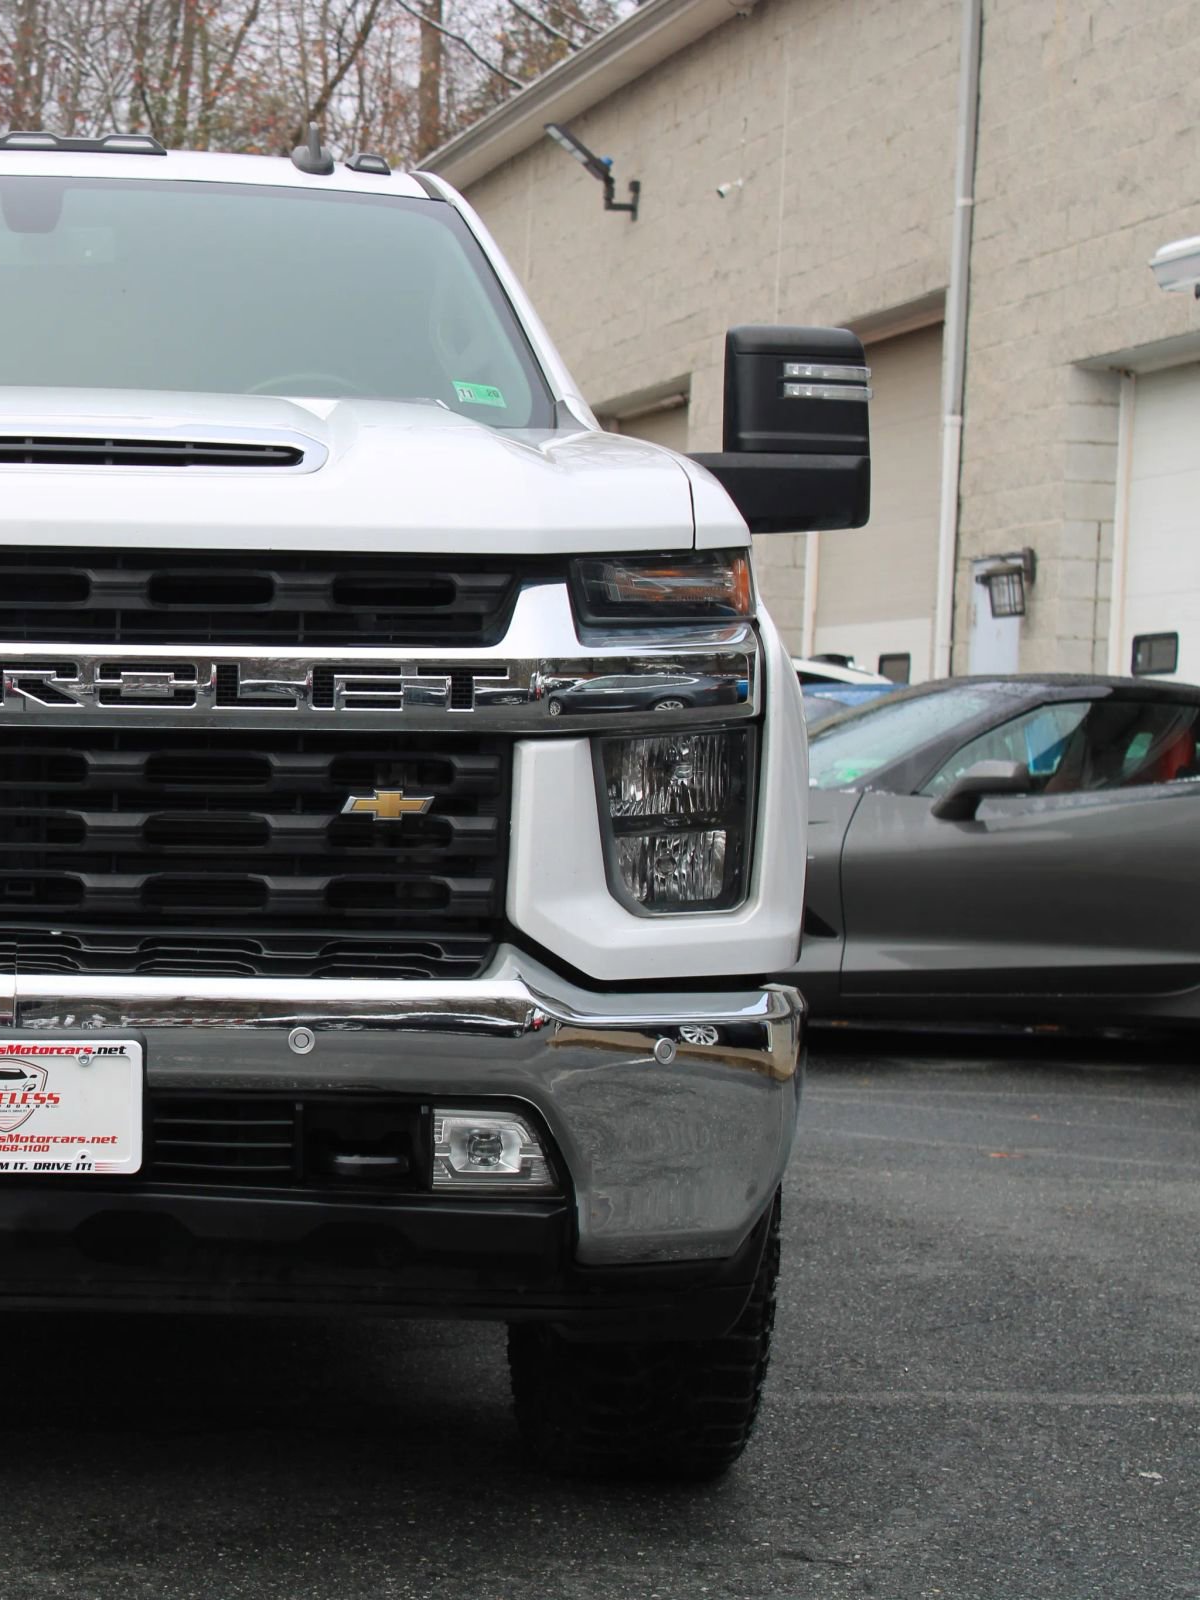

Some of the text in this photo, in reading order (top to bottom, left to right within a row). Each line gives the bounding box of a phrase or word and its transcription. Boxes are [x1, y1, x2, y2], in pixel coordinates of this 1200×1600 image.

[12, 1162, 29, 1171] IT.
[33, 1162, 71, 1171] DRIVE
[75, 1162, 92, 1171] IT!
